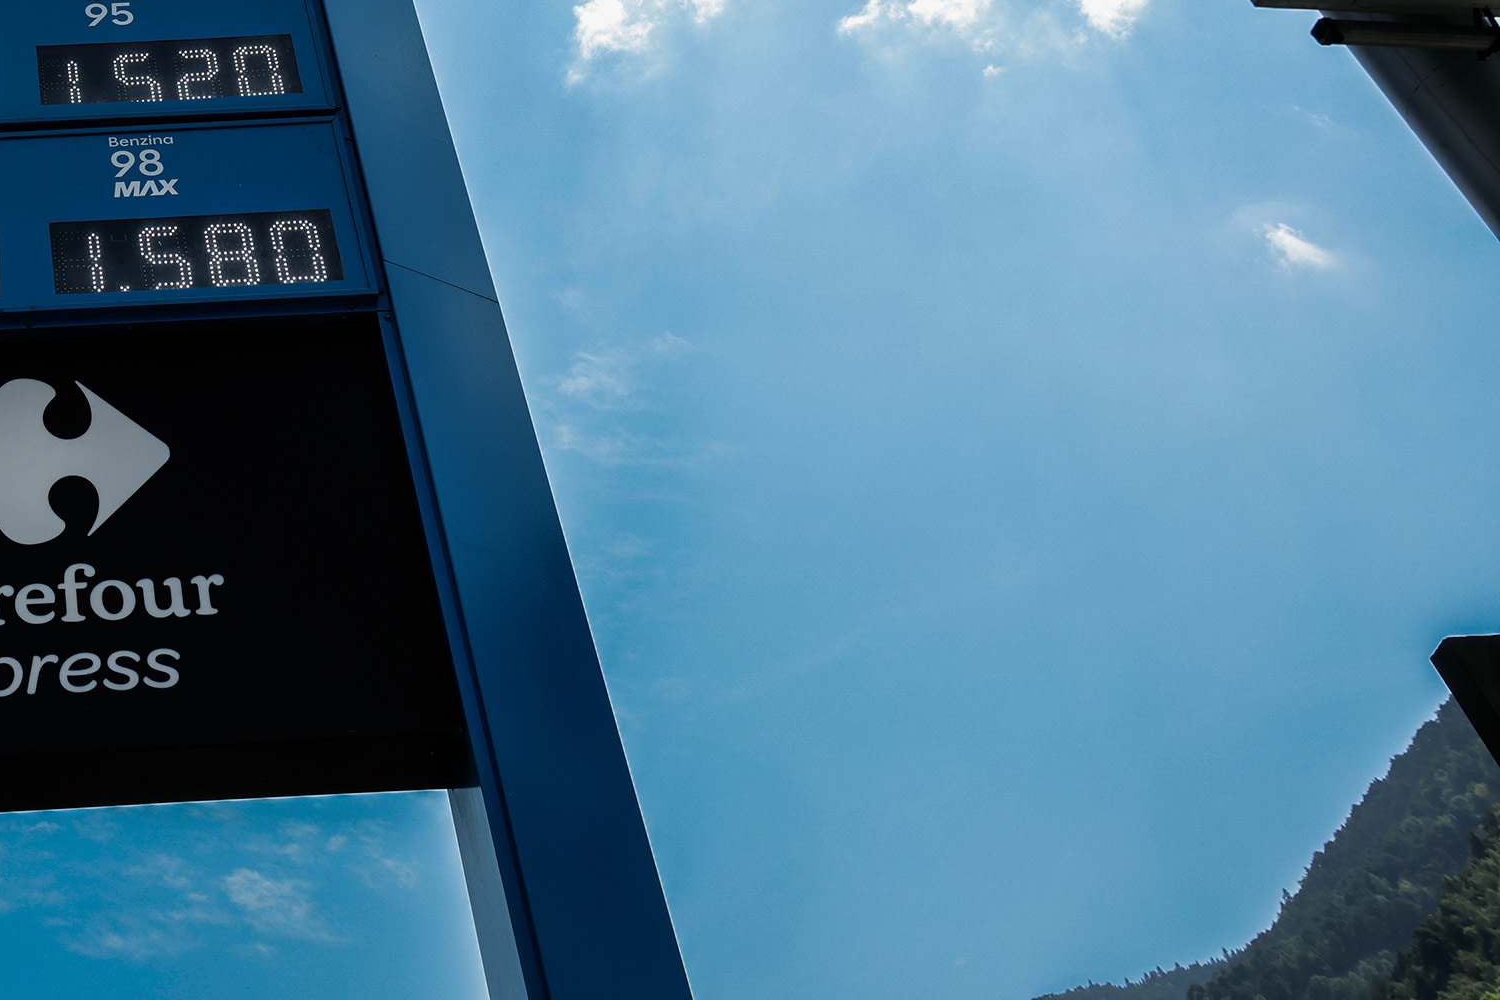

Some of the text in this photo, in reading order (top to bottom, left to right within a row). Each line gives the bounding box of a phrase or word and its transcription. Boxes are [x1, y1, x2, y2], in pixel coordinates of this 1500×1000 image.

[85, 2, 134, 27] 95
[108, 135, 174, 148] Benzina
[110, 149, 165, 178] 98
[113, 178, 179, 198] MAX
[87, 219, 328, 293] 1.580
